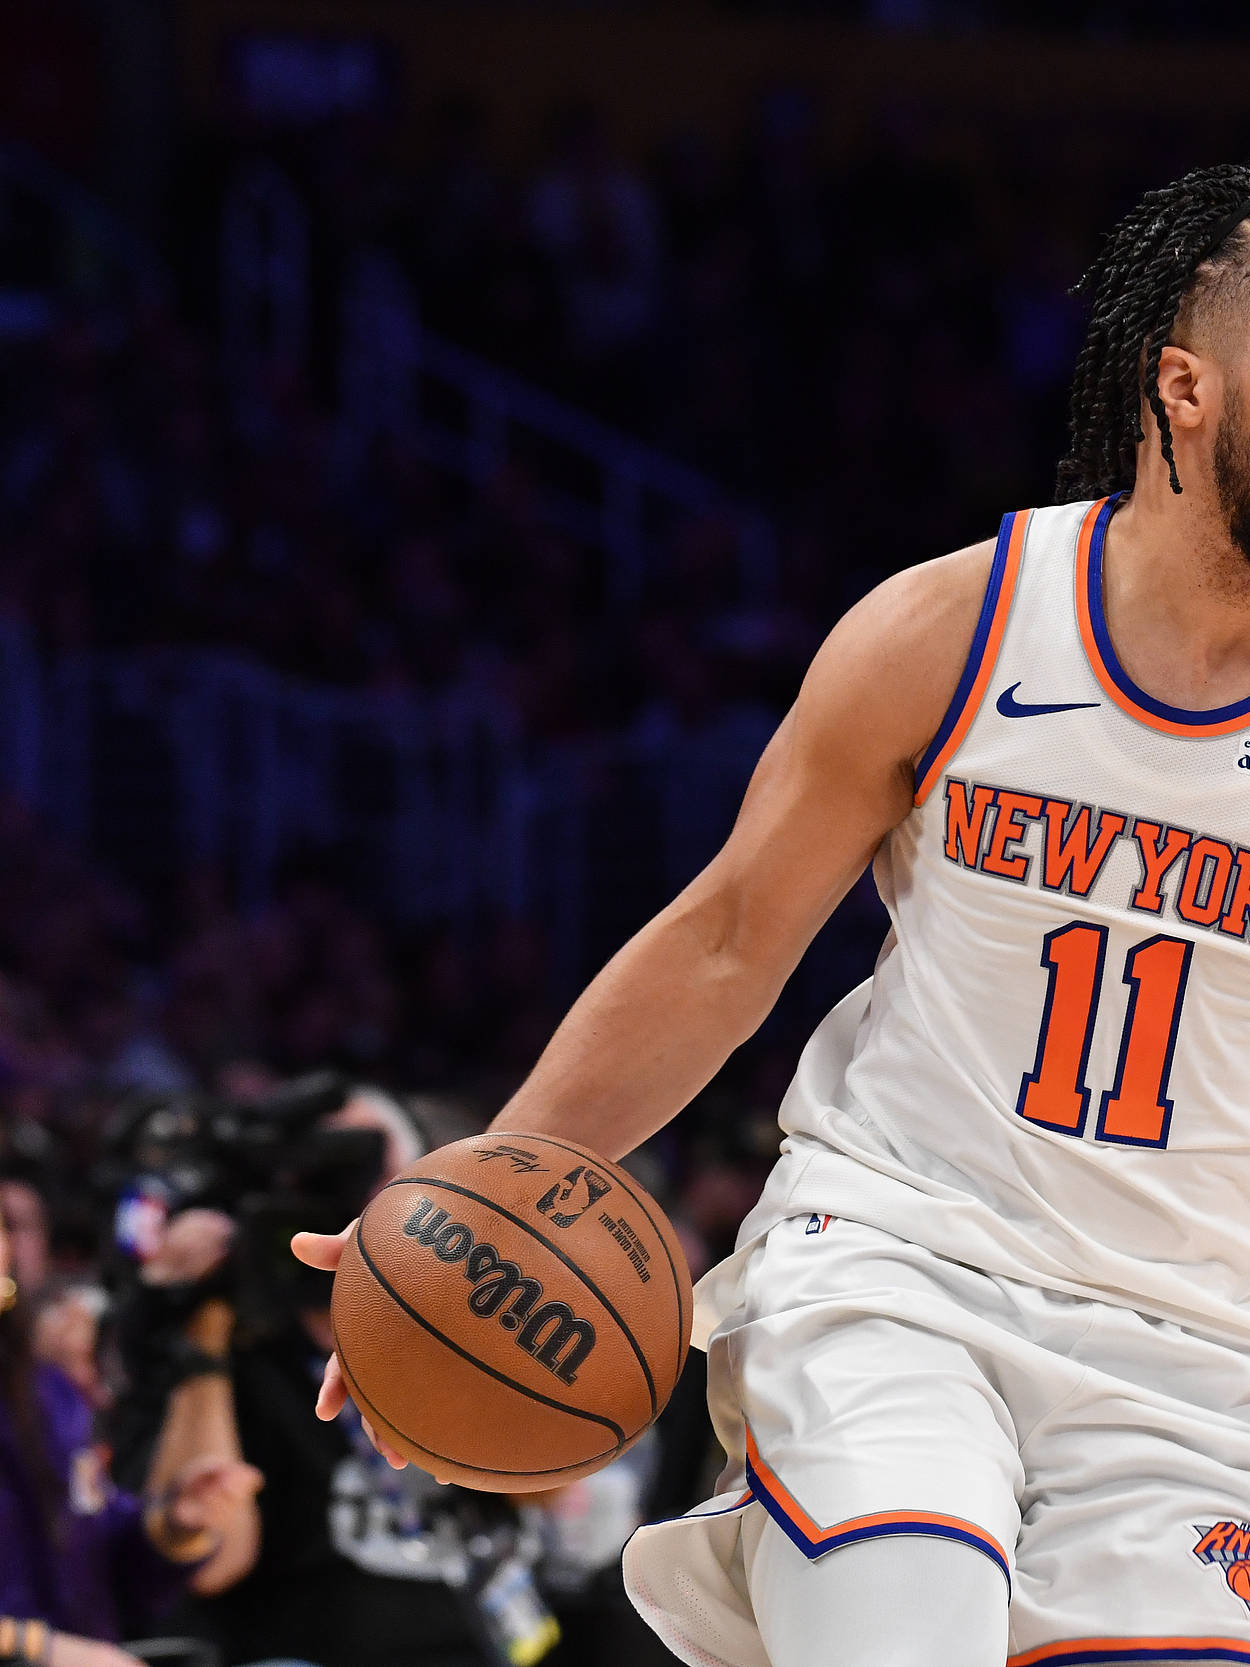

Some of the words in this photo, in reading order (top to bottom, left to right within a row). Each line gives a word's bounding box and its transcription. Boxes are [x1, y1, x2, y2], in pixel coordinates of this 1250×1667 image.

[943, 775, 1128, 899] NEW
[1016, 920, 1195, 1150] 11
[598, 1212, 617, 1232] BALL
[612, 1228, 631, 1251] GAME
[404, 1197, 596, 1386] Wilson
[627, 1248, 650, 1283] OFFICIAL
